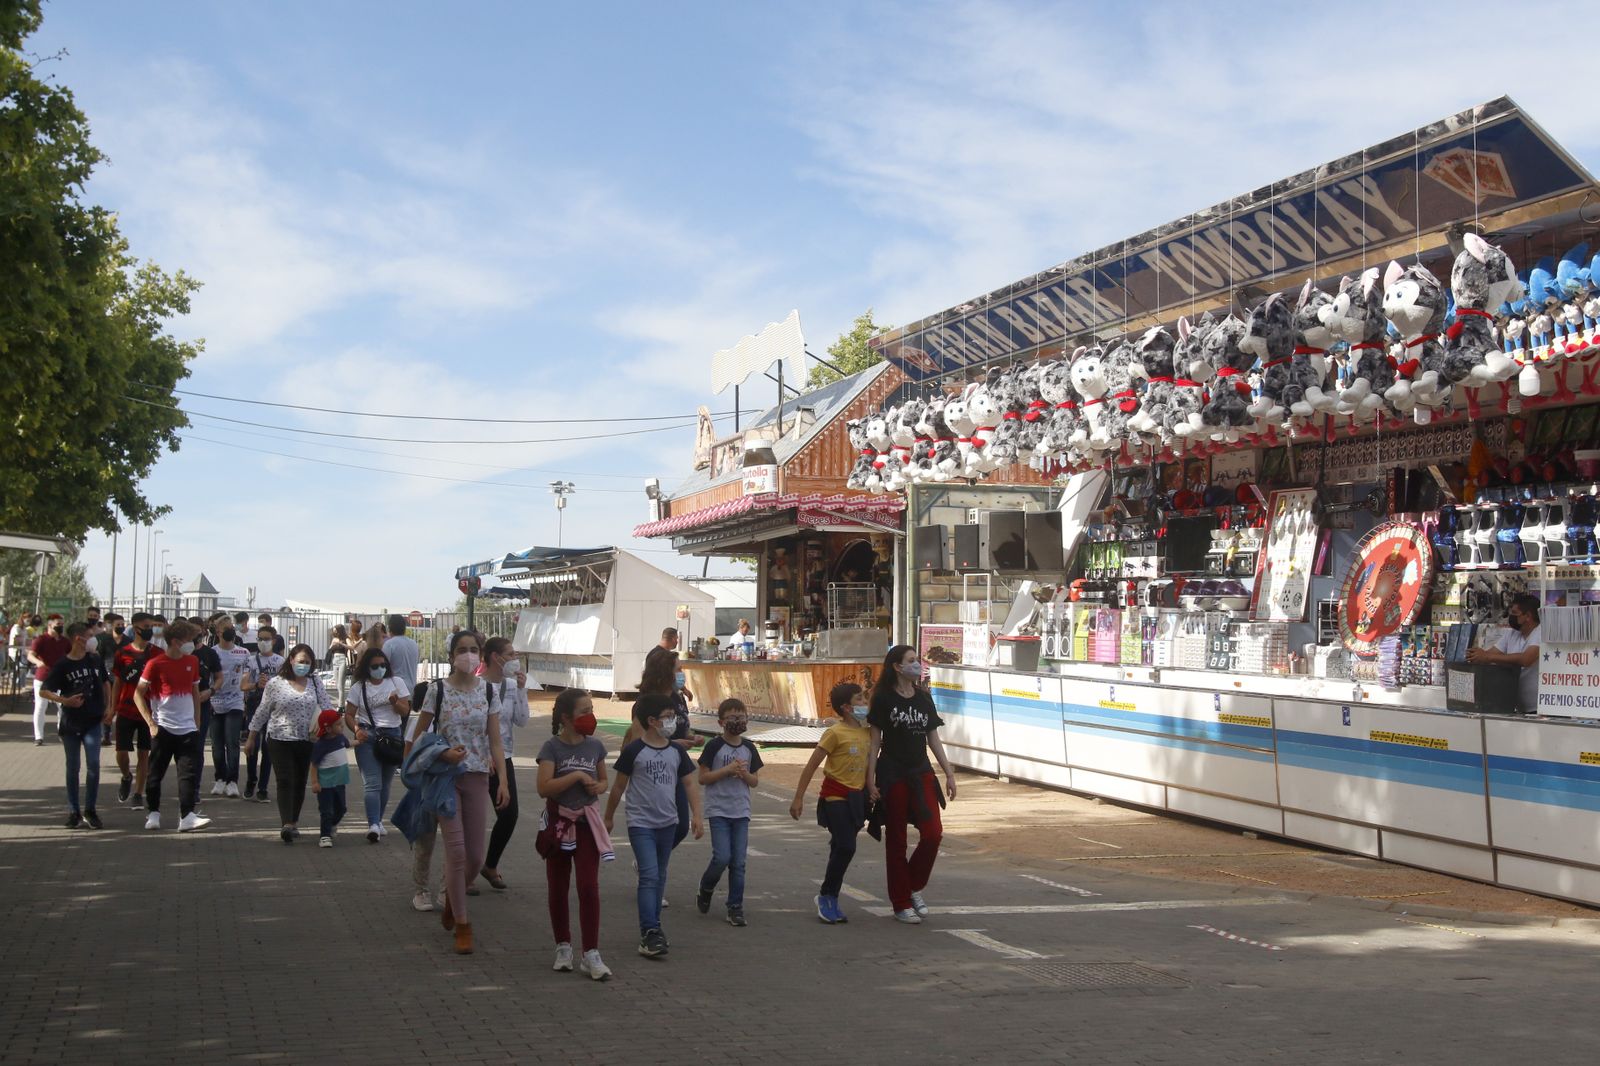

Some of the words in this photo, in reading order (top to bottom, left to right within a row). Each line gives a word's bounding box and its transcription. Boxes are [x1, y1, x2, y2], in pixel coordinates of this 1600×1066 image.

[926, 314, 1020, 366] GRAN
[994, 277, 1126, 343] BAZAR
[1140, 174, 1415, 295] TOMBOLAY
[798, 512, 830, 524] Crepes
[1565, 653, 1589, 667] AQUI
[1541, 673, 1584, 687] SIEMPRE
[1539, 694, 1574, 707] PREMIO
[646, 760, 667, 775] Harry
